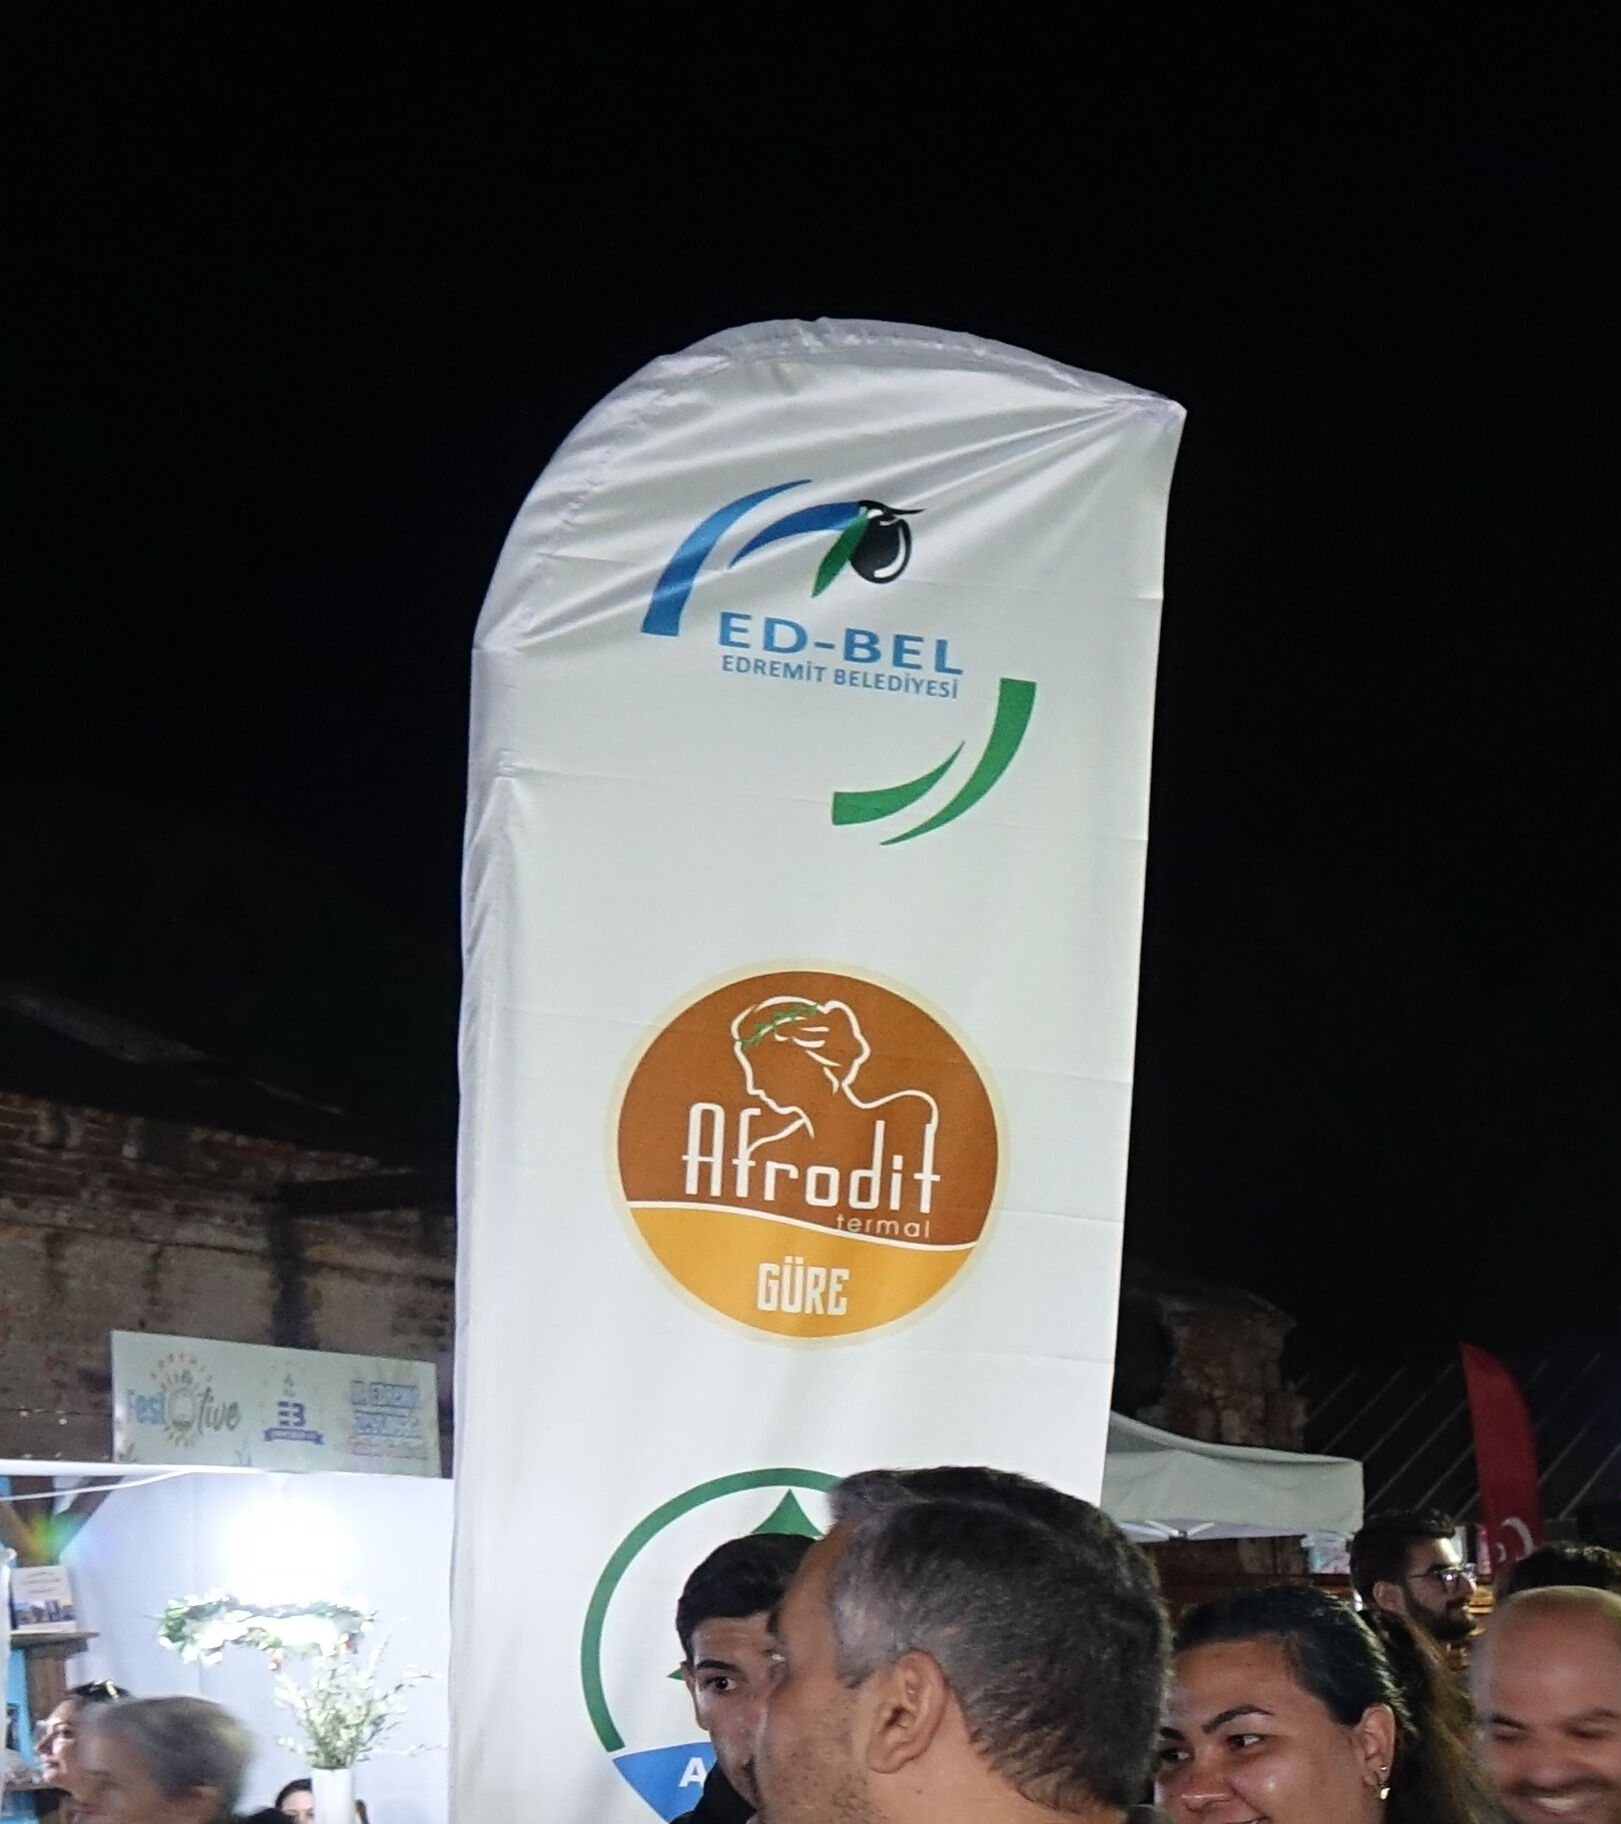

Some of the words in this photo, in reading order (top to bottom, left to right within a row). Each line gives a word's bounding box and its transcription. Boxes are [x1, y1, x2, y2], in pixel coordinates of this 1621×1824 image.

[719, 611, 963, 675] ED-BEL
[722, 654, 827, 683] EDREMİT
[833, 668, 959, 700] BELEDİYESİ
[682, 1102, 941, 1214] Afrodit
[837, 1213, 930, 1238] termal
[757, 1256, 850, 1316] GÜRE
